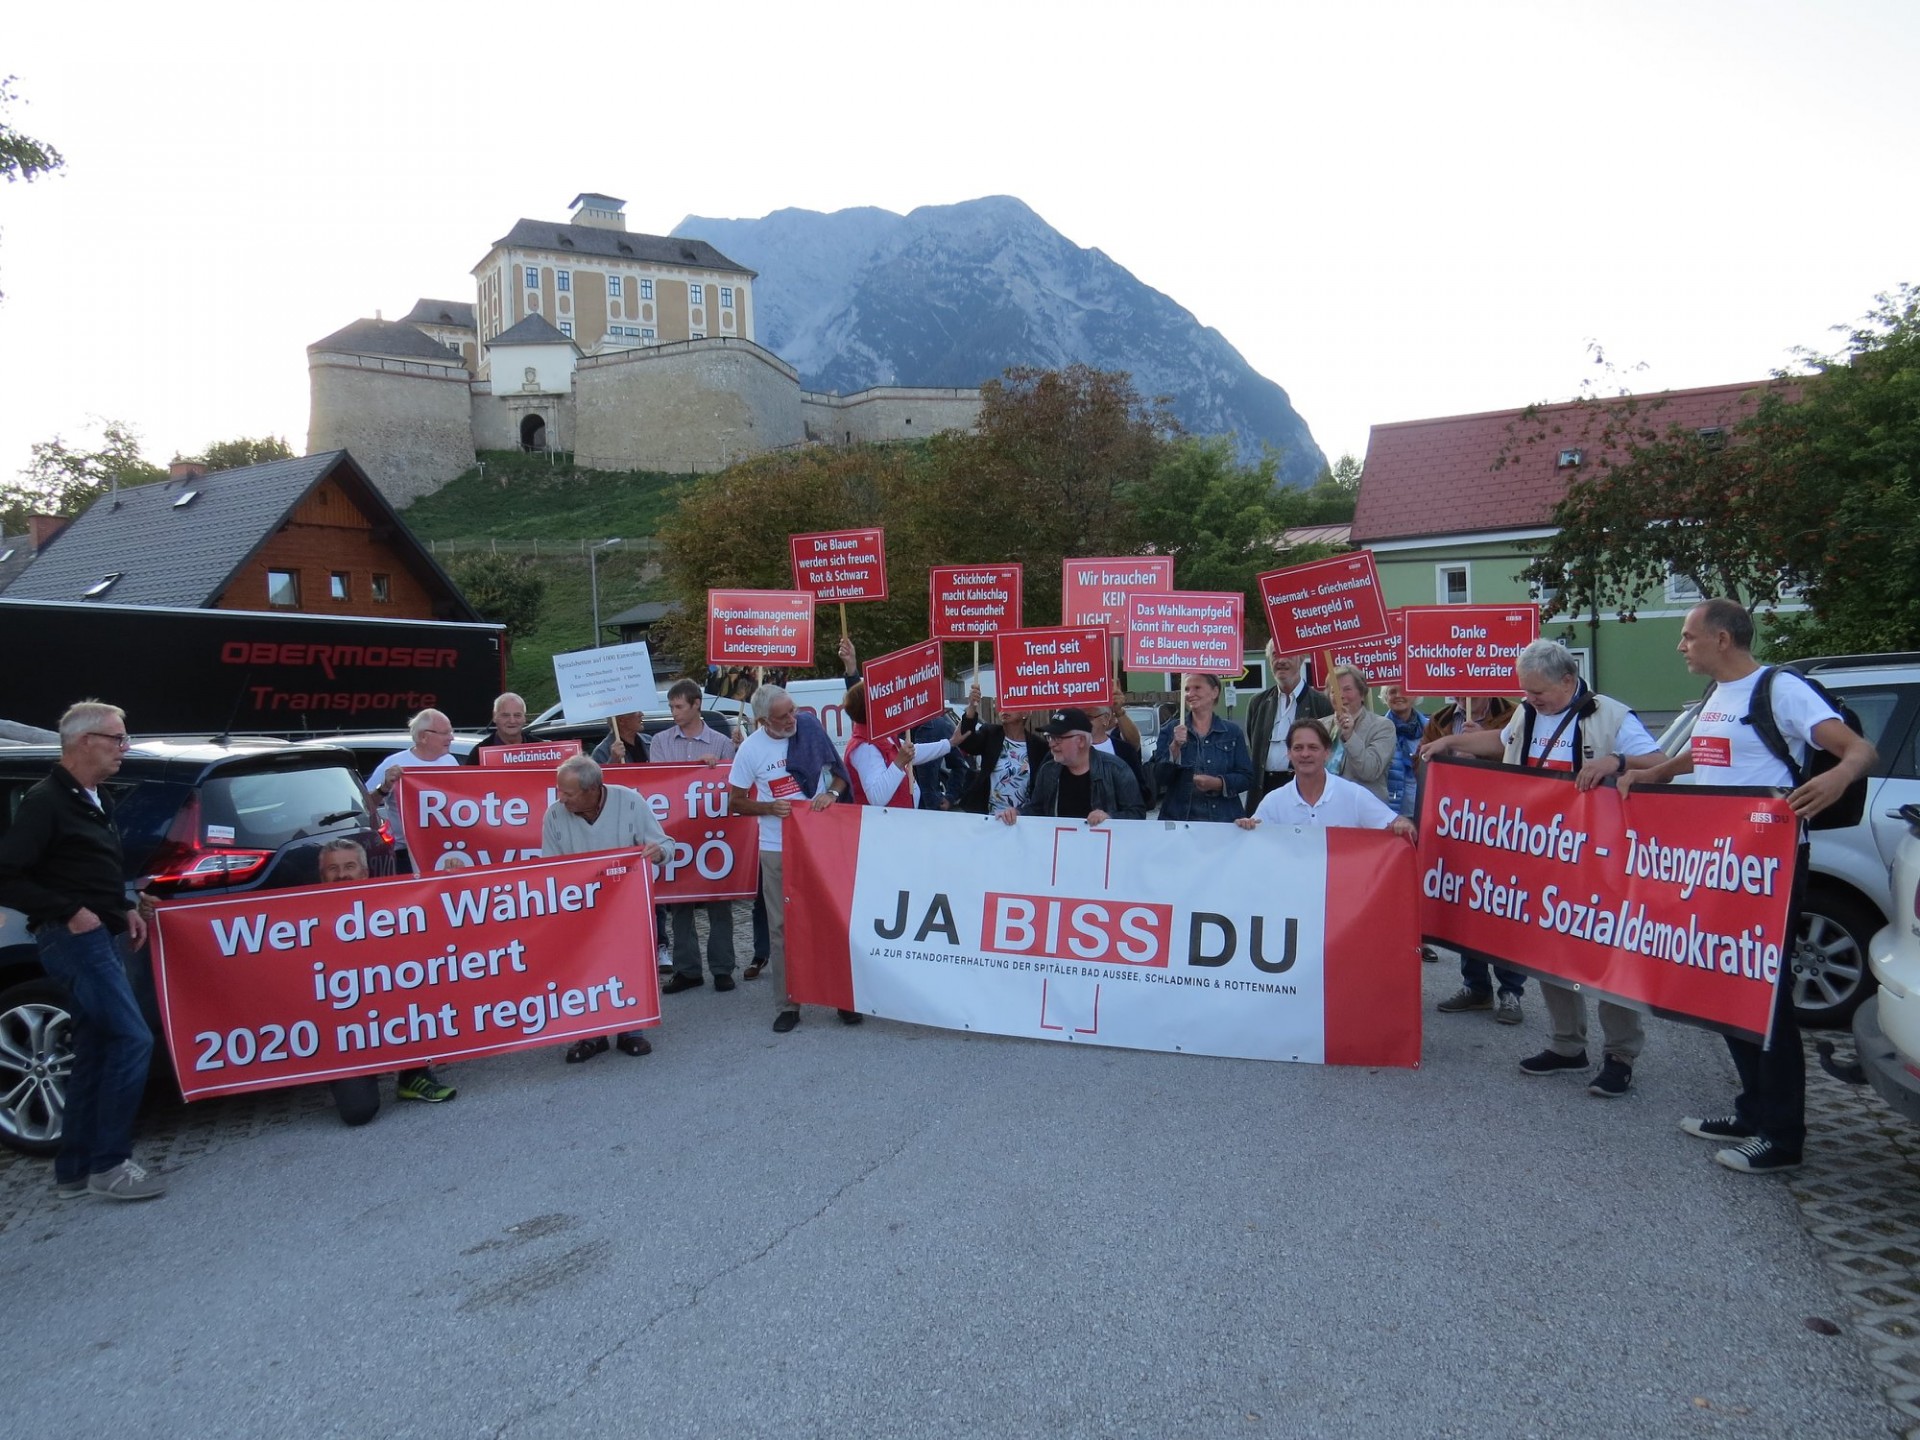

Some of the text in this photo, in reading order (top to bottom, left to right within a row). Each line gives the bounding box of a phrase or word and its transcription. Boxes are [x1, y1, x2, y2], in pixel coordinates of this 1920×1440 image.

[814, 538, 858, 552] Die Blauen
[799, 553, 877, 569] werden sich freuen,
[809, 569, 869, 583] Rot & Schwarz
[953, 572, 997, 585] Schickhofer
[1078, 569, 1156, 586] Wir brauchen
[817, 584, 864, 598] wird heulen
[942, 588, 1008, 603] macht Kahlschlag
[1268, 588, 1309, 606] Steiermark
[1318, 574, 1371, 596] Griechenland
[713, 607, 809, 622] Regionalmanagement
[945, 604, 1005, 617] beu Gesundheit
[1137, 604, 1232, 620] Das Wahlkampfgeld
[1291, 597, 1354, 620] Steuergeld in
[724, 624, 797, 637] in Geiselhaft der
[950, 620, 998, 635] erst möglich
[1131, 619, 1236, 636] könnt ihr euch sparen,
[1295, 614, 1360, 639] falscher Hand
[1451, 625, 1487, 640] Danke
[723, 641, 797, 656] Landesregierung
[1024, 638, 1080, 656] Trend seit
[1140, 636, 1227, 650] die Blauen werden
[1407, 644, 1527, 659] Schickhofer & Drexle
[220, 642, 458, 680] OBERMOSER
[1135, 652, 1231, 667] ins Landhaus fahren
[1334, 649, 1397, 666] das Ergebnis
[1016, 659, 1090, 677] vielen Jahren
[1362, 667, 1375, 679] ie
[1425, 663, 1456, 677] Volks
[1466, 663, 1513, 678] Verräter
[869, 661, 940, 701] Wisst ihr wirklich
[1031, 680, 1059, 696] nicht
[250, 687, 437, 715] Transporte
[885, 690, 929, 719] was ihr tut
[503, 749, 562, 764] Medizinische
[419, 789, 530, 829] Rote
[684, 780, 741, 820] fü
[1435, 797, 1588, 865] Schickhofer
[652, 830, 735, 882] PÖ
[211, 876, 602, 957] Wer den Wähler
[1423, 858, 1779, 986] der Steir. Sozialdemokratie
[873, 890, 1298, 974] JA BISS DU
[313, 939, 527, 1010] ignoriert
[869, 948, 1298, 996] JA ZUR STANDORTERHALTUNG DER SPITÄLER BAD AUSSEE, SCHLADMING & ROTTENMANN
[194, 976, 638, 1072] 2020 nicht regiert.
